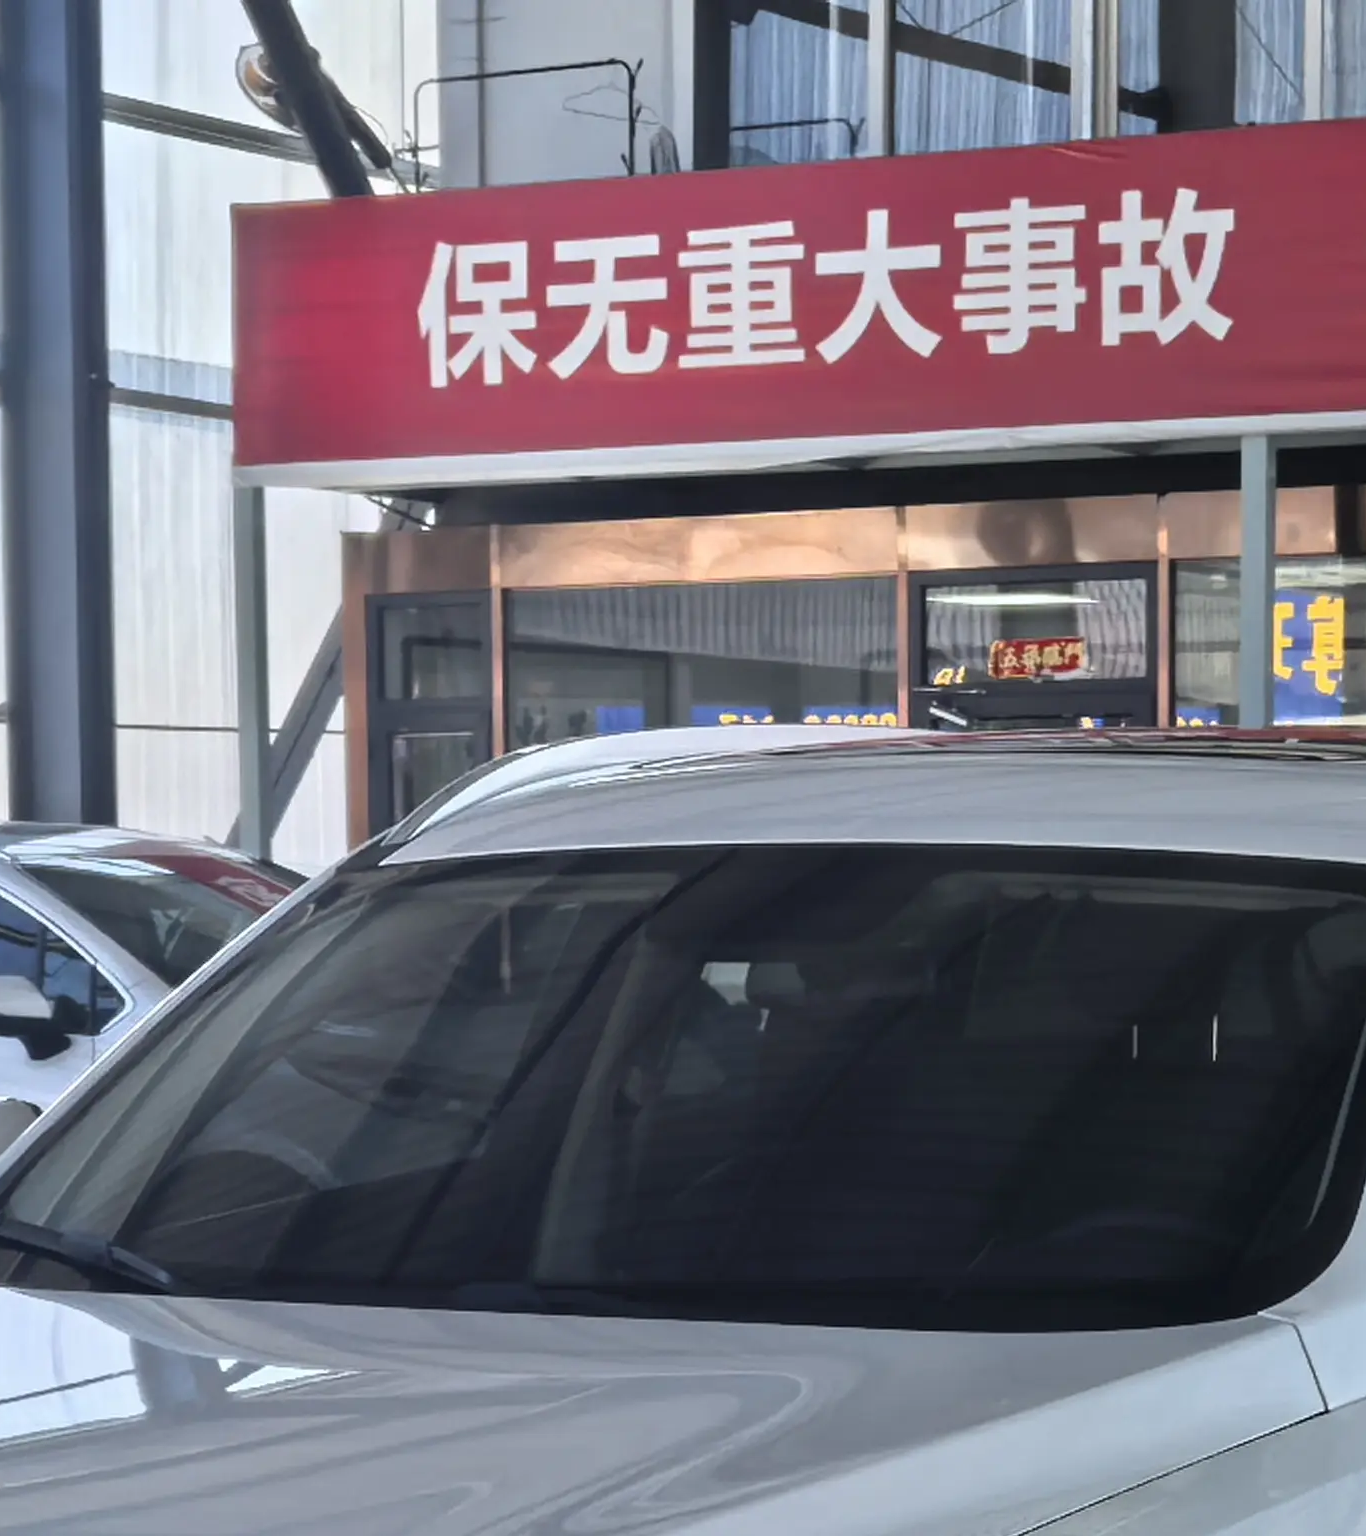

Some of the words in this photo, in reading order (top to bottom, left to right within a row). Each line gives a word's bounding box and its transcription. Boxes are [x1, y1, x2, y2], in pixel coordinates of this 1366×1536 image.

[416, 187, 1237, 390] 保无重大事故
